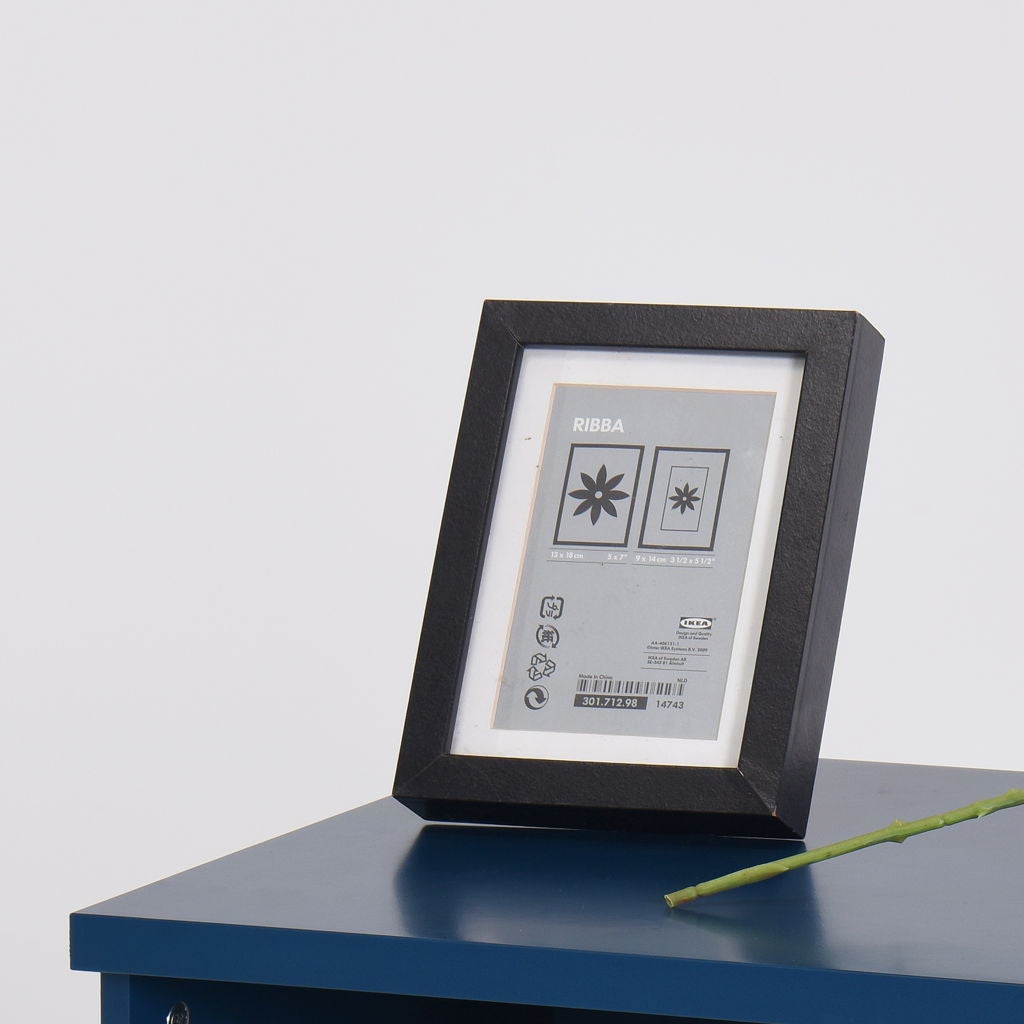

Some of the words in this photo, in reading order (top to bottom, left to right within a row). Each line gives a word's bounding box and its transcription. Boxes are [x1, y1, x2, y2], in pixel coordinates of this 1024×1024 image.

[572, 416, 625, 433] RIBBA
[582, 696, 638, 708] 301.712.98
[655, 699, 684, 709] 14743
